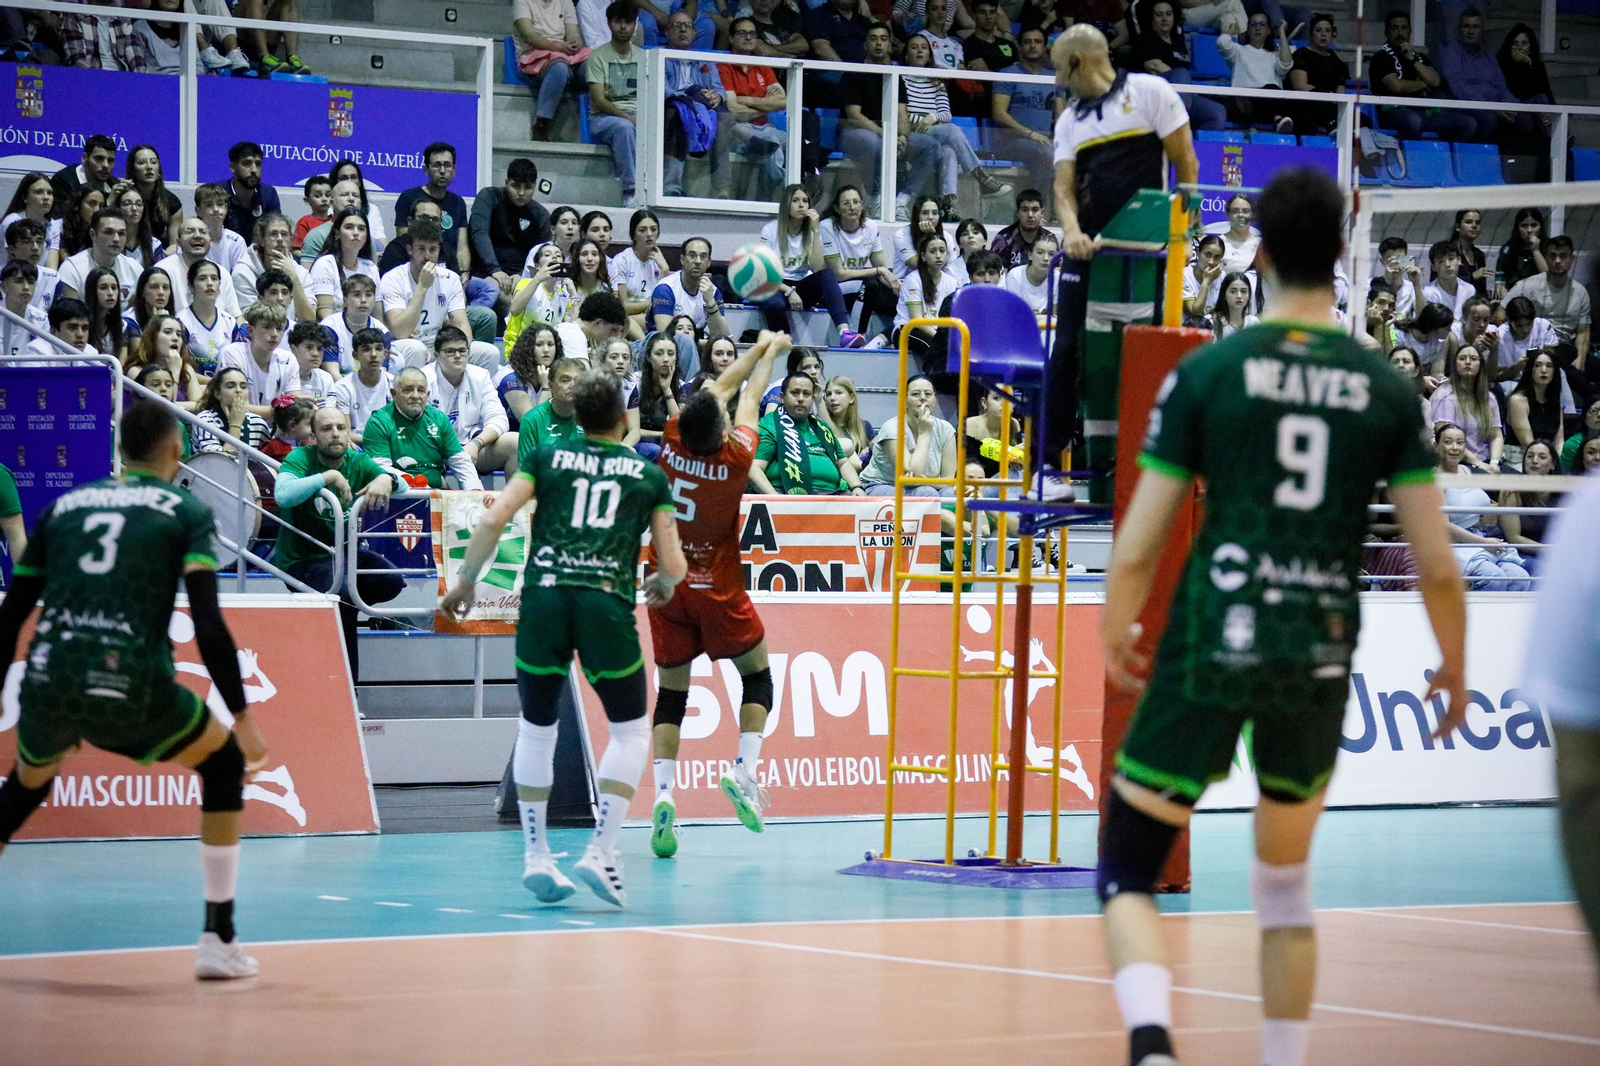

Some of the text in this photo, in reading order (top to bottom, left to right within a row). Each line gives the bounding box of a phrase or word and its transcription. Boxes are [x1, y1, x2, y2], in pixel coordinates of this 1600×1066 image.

[34, 130, 55, 146] DE
[58, 132, 129, 152] ALMÍA
[260, 143, 426, 169] IPUTACIÓN DE ALMERÍA
[1010, 251, 1021, 264] 24
[640, 279, 647, 293] 2
[420, 309, 430, 326] 2
[545, 308, 555, 323] 21
[551, 450, 645, 480] FRAN RUIZ
[661, 443, 729, 481] PAQUILLO
[1274, 413, 1330, 511] 9
[570, 477, 622, 529] 10
[672, 477, 699, 522] 5
[78, 512, 126, 575] 3
[862, 536, 914, 546] LA UNON
[1338, 668, 1552, 754] Unica
[783, 756, 888, 788] VOLEIBOL
[892, 753, 1011, 785] MASCULINA
[53, 775, 203, 807] MASCULINA
